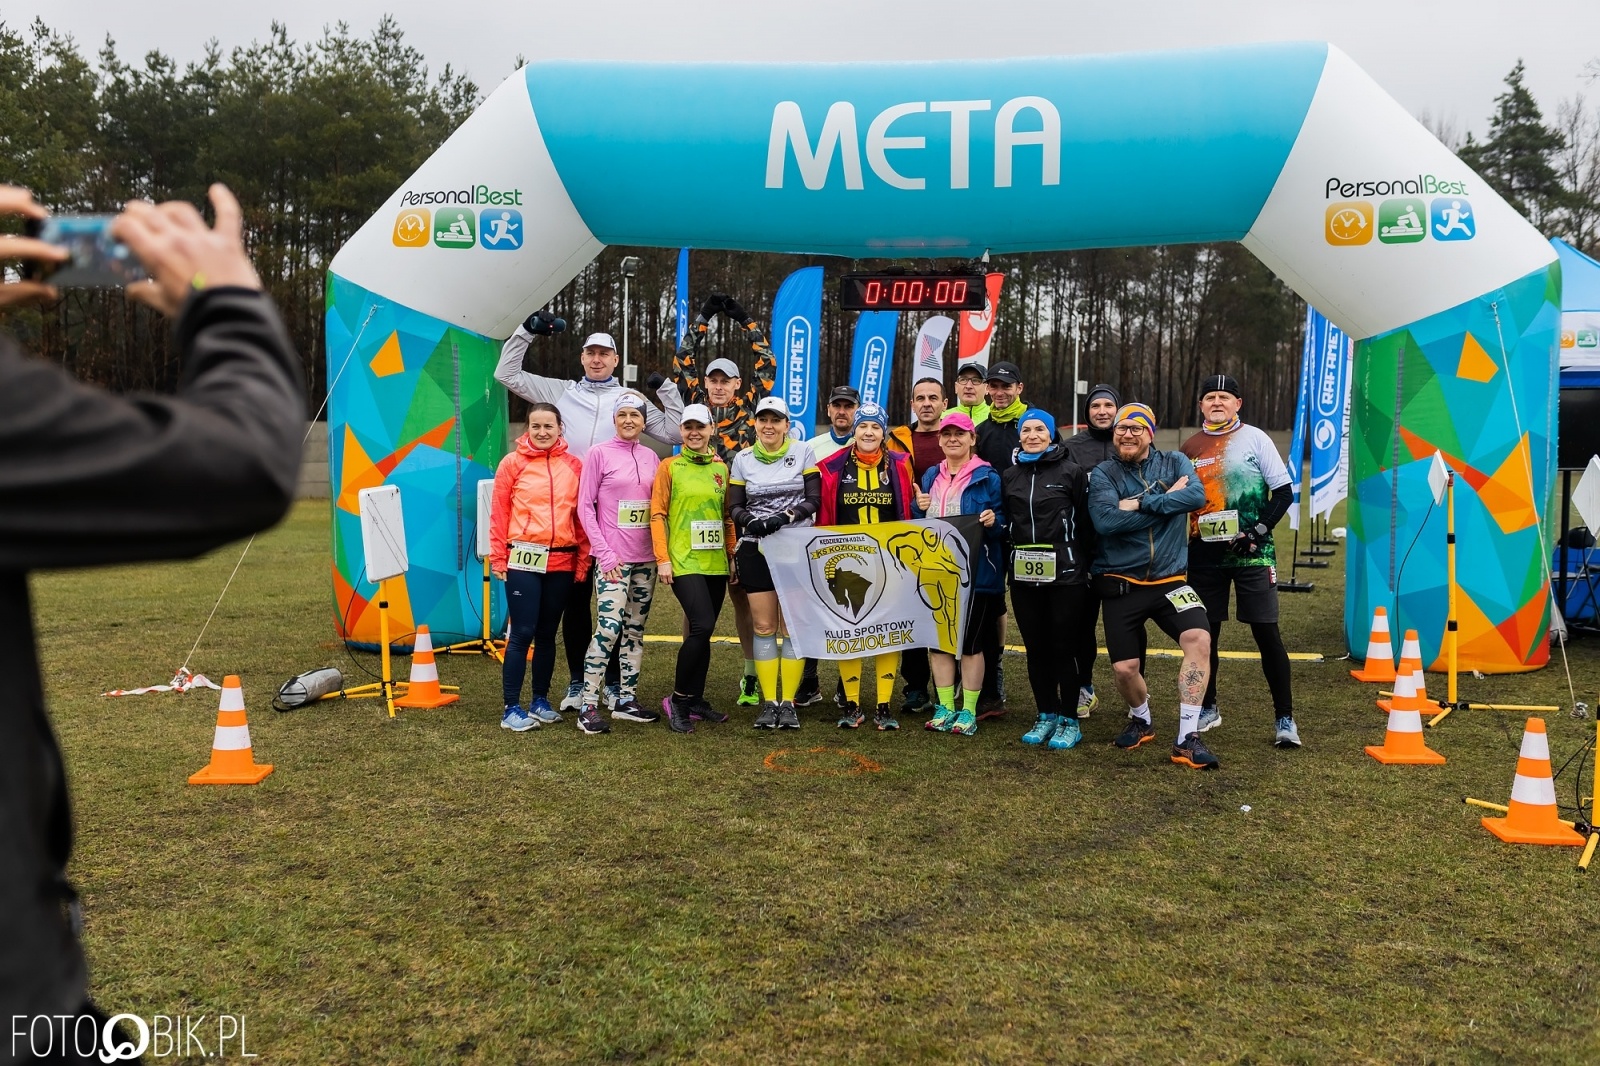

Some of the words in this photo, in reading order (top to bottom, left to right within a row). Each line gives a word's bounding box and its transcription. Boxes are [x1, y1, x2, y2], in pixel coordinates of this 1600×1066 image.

[765, 96, 1061, 190] META
[400, 185, 523, 207] PersonalBest
[1325, 174, 1469, 199] PersonalBest
[865, 281, 967, 303] 0:00:00
[789, 325, 805, 406] RAFAMET
[863, 343, 882, 404] AFAMET
[1322, 322, 1339, 405] RAFAMET
[629, 510, 645, 523] 57
[1209, 520, 1228, 535] 74
[698, 530, 720, 544] 155
[516, 550, 542, 566] 107
[1025, 561, 1044, 576] 98
[1178, 592, 1200, 604] 18
[825, 629, 851, 639] KLUB
[854, 620, 915, 637] SPORTOWY
[826, 629, 914, 654] KOZIOŁEK
